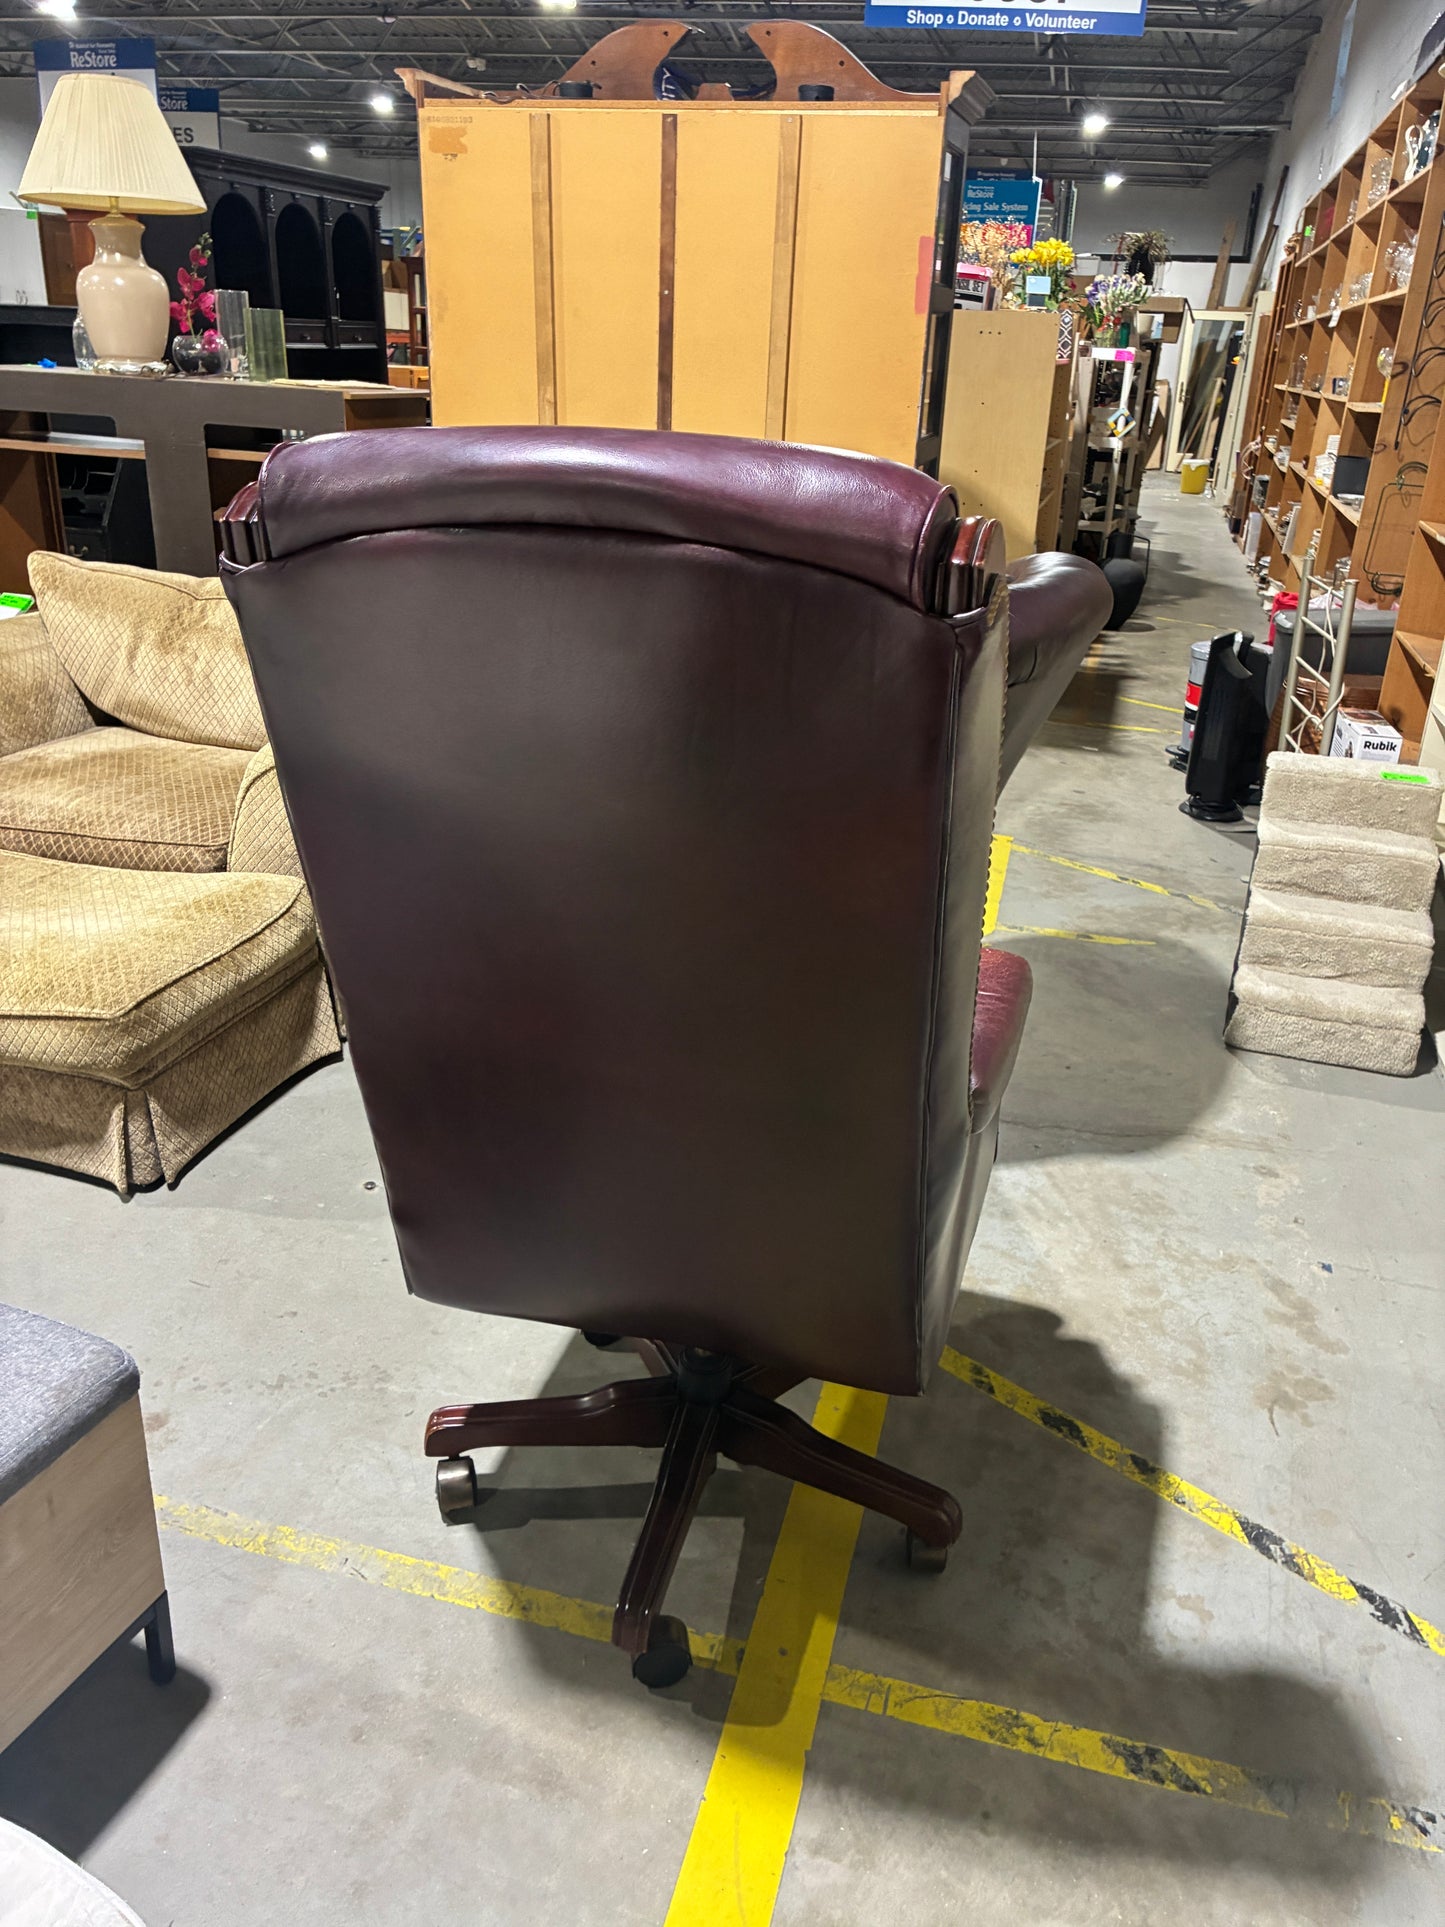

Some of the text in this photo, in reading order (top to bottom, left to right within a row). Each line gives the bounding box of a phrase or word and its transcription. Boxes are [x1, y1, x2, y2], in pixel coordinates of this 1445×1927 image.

[907, 10, 1097, 29] Shop Donate Volunteer
[70, 51, 117, 67] ReStore
[661, 67, 676, 100] ITY
[160, 96, 188, 110] Store
[173, 127, 194, 144] ES
[967, 189, 994, 198] ReStore
[963, 202, 1029, 212] icing Sale System
[1363, 741, 1397, 751] Rubik
